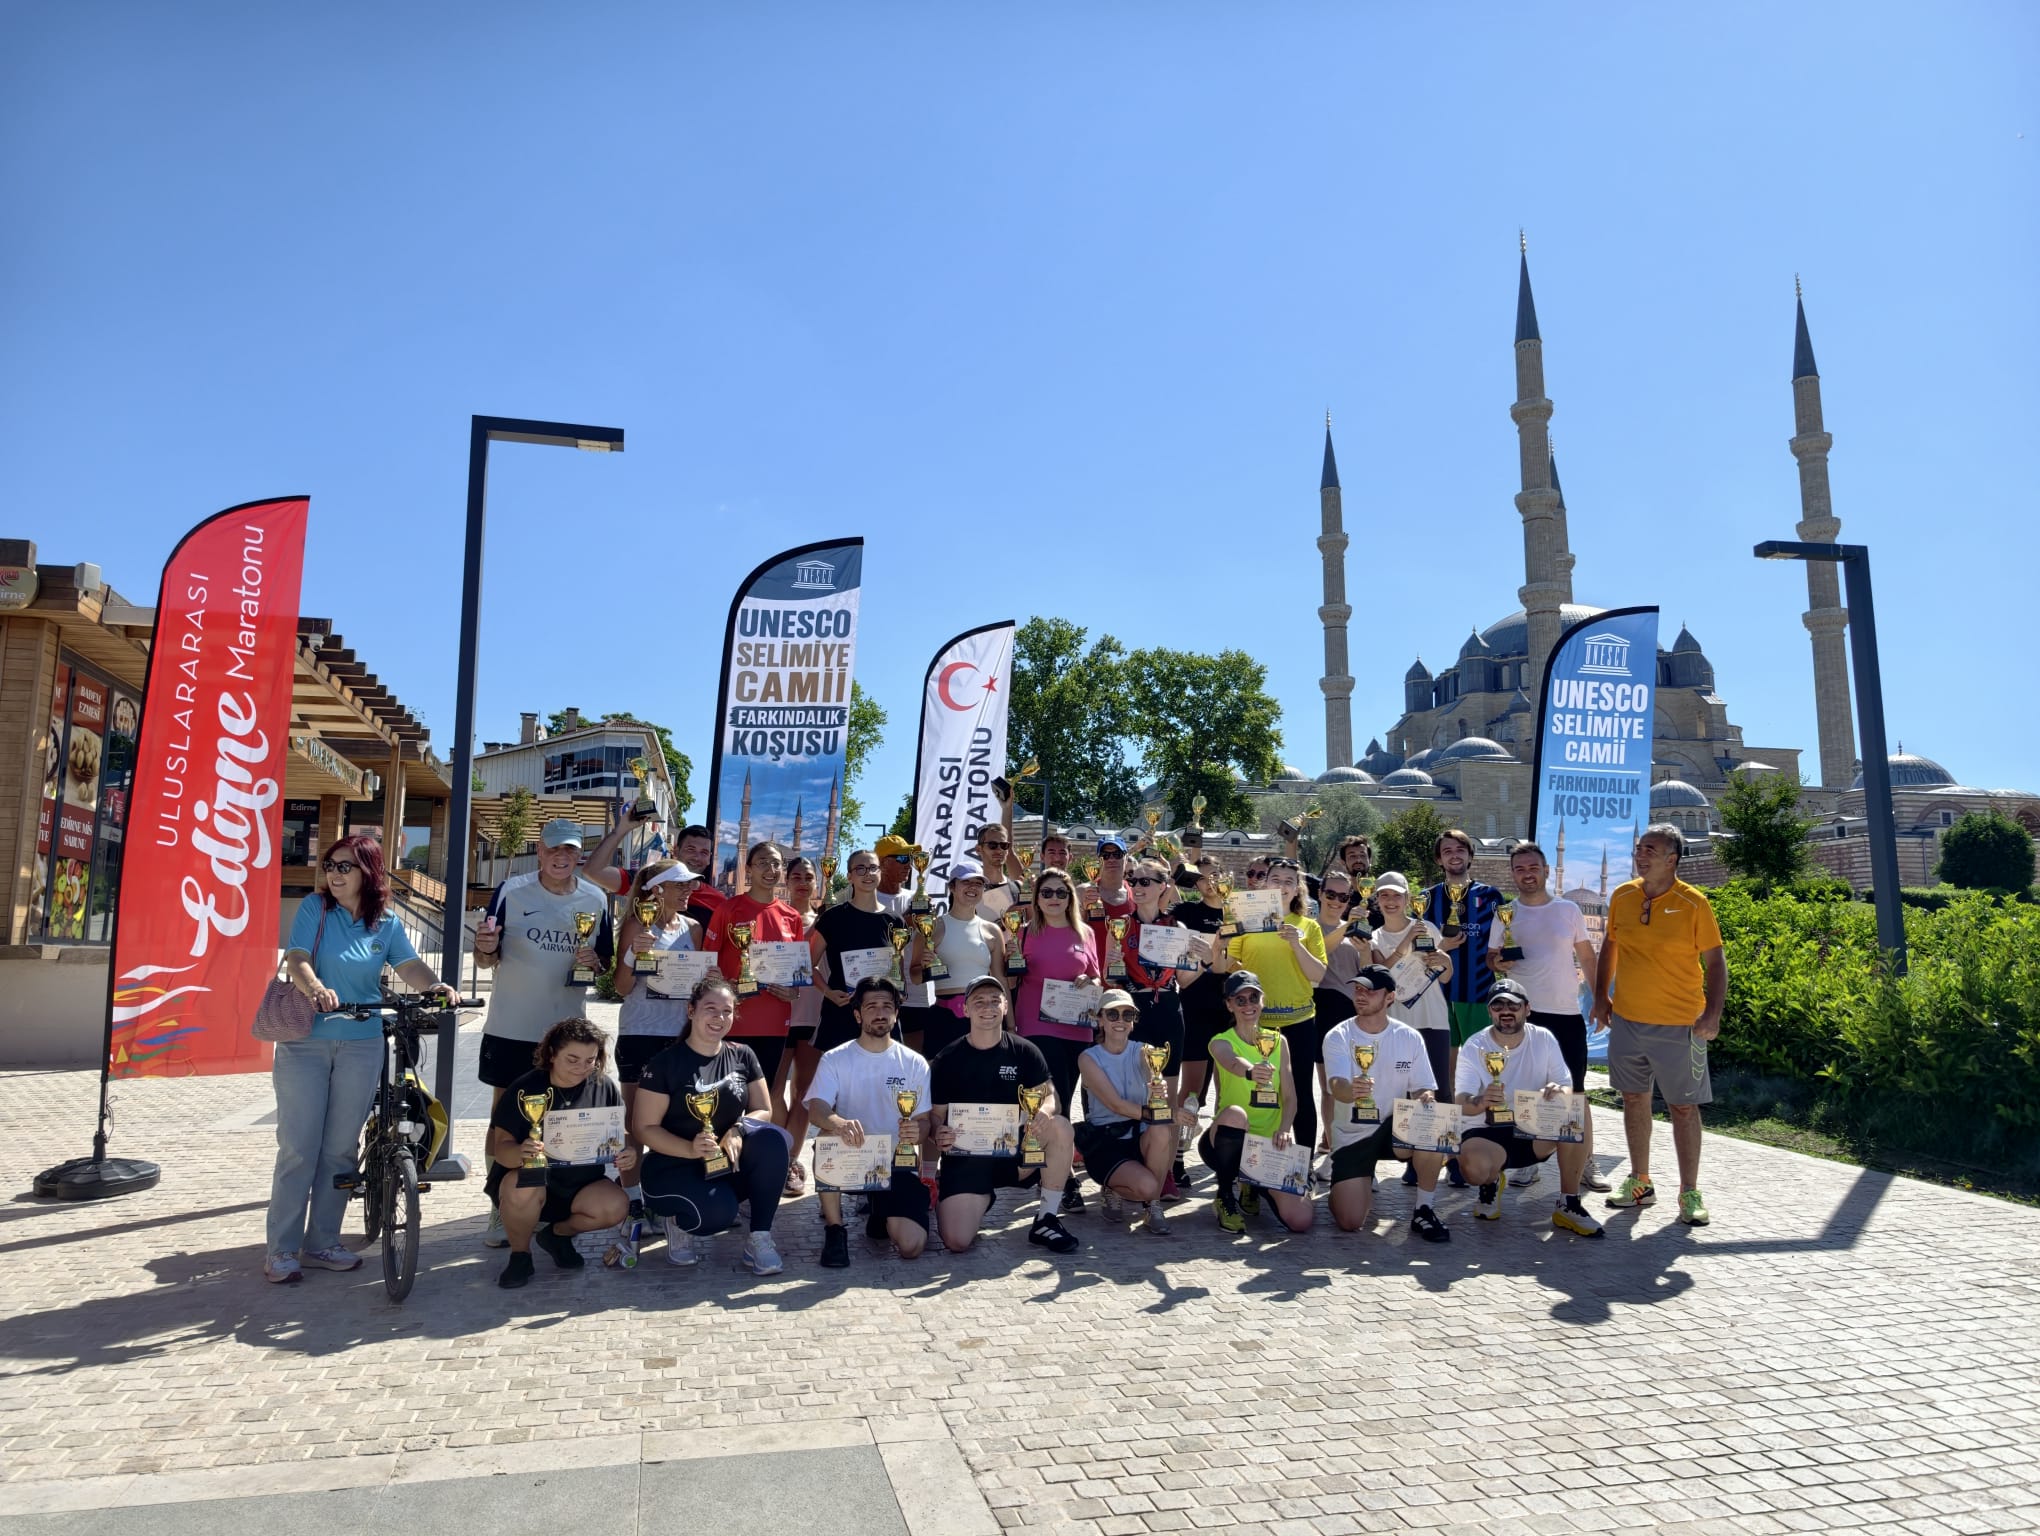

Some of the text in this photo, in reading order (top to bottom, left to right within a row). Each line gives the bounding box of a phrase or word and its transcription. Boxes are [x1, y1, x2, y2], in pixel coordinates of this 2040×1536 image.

[797, 568, 833, 584] UNESCO
[0, 588, 26, 600] irne
[739, 608, 851, 639] UNESCO
[736, 640, 850, 668] SELİMİYE
[1585, 644, 1628, 667] UNESCO
[735, 668, 846, 703] CAMİİ
[1552, 679, 1649, 713] UNESCO
[156, 573, 209, 847] ULUSLARARASI
[738, 709, 840, 726] FARKINDALIK
[1551, 710, 1645, 739] SELİMİYE
[181, 525, 279, 957] Edirne Maratonu
[731, 729, 839, 761] KOŞUSU
[1565, 739, 1626, 765] CAMİİ
[964, 727, 992, 864] ARATONU
[1548, 774, 1640, 795] FARKINDALIK
[291, 803, 317, 811] Edirne
[1552, 794, 1632, 824] KOŞUSU
[540, 943, 576, 954] AIRWAY
